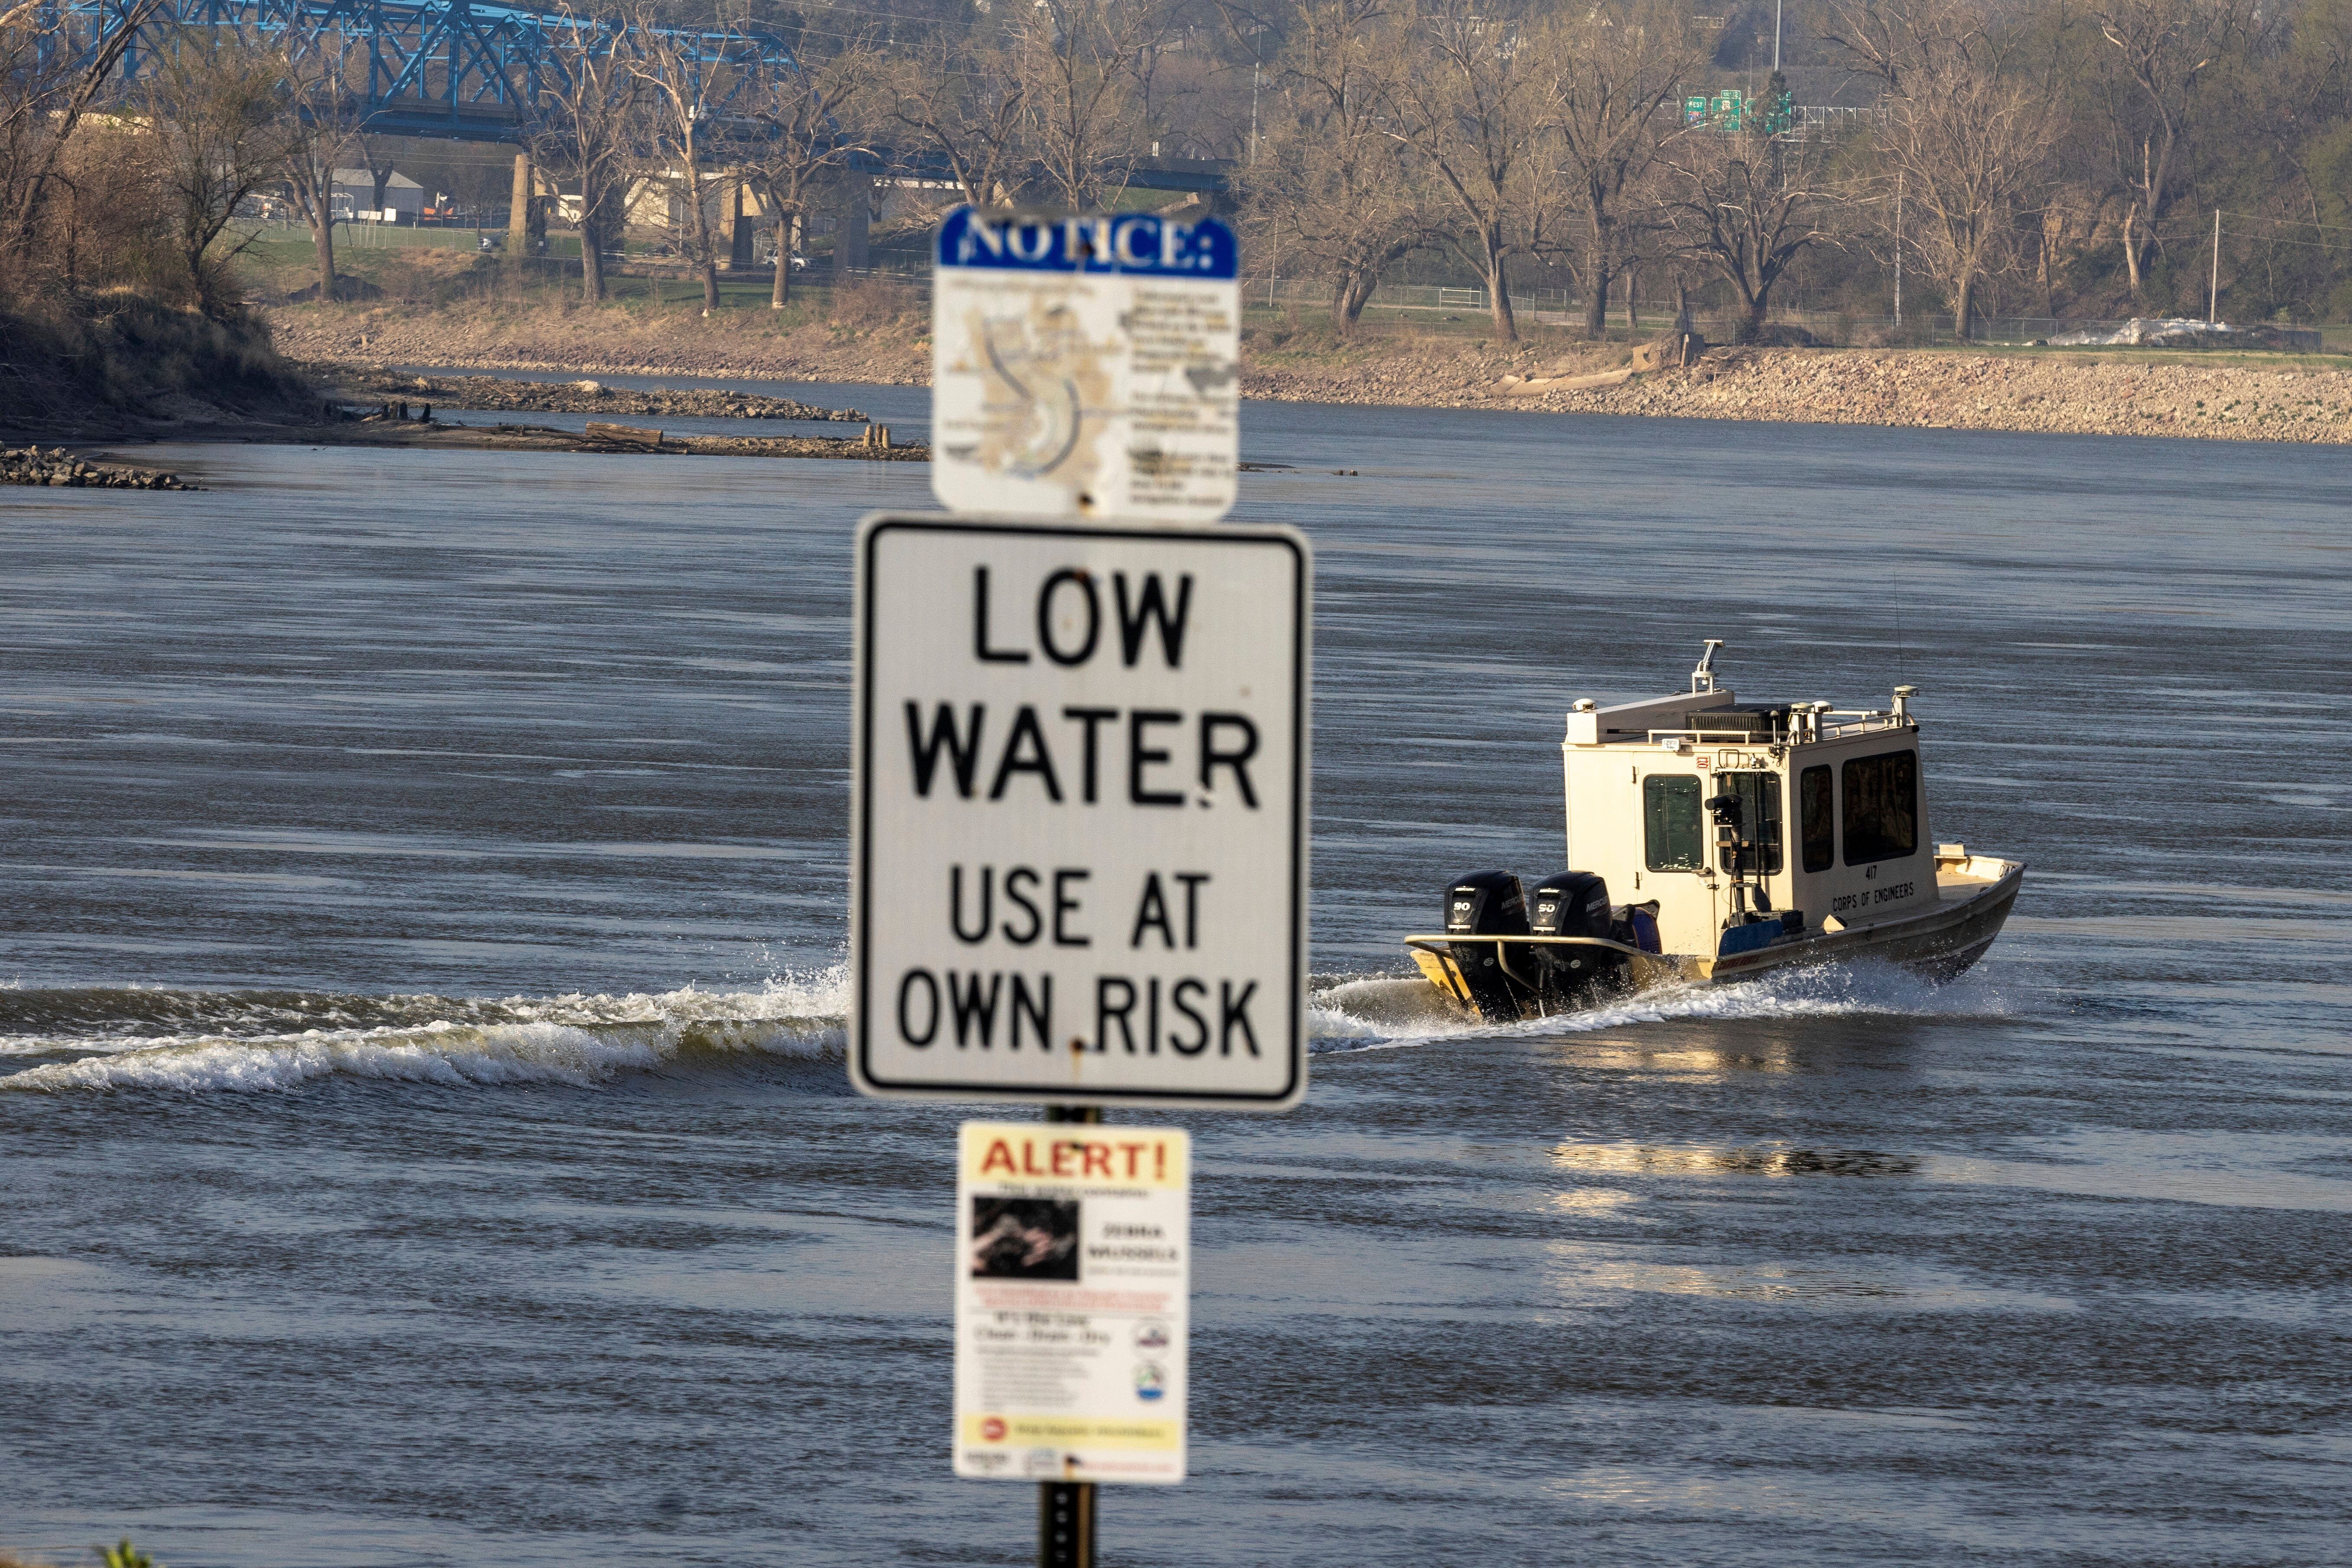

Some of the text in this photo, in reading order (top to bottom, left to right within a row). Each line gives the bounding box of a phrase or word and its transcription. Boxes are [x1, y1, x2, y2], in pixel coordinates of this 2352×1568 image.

[973, 564, 1194, 670] LOW
[903, 699, 1261, 811] WATER
[1833, 881, 1914, 912] CORPS OF ENGINEERS
[1865, 865, 1878, 880] 417
[949, 864, 1211, 951] USE AT
[1453, 902, 1470, 911] 90
[895, 966, 1261, 1059] OWN RISK
[980, 1137, 1167, 1179] ALERT!
